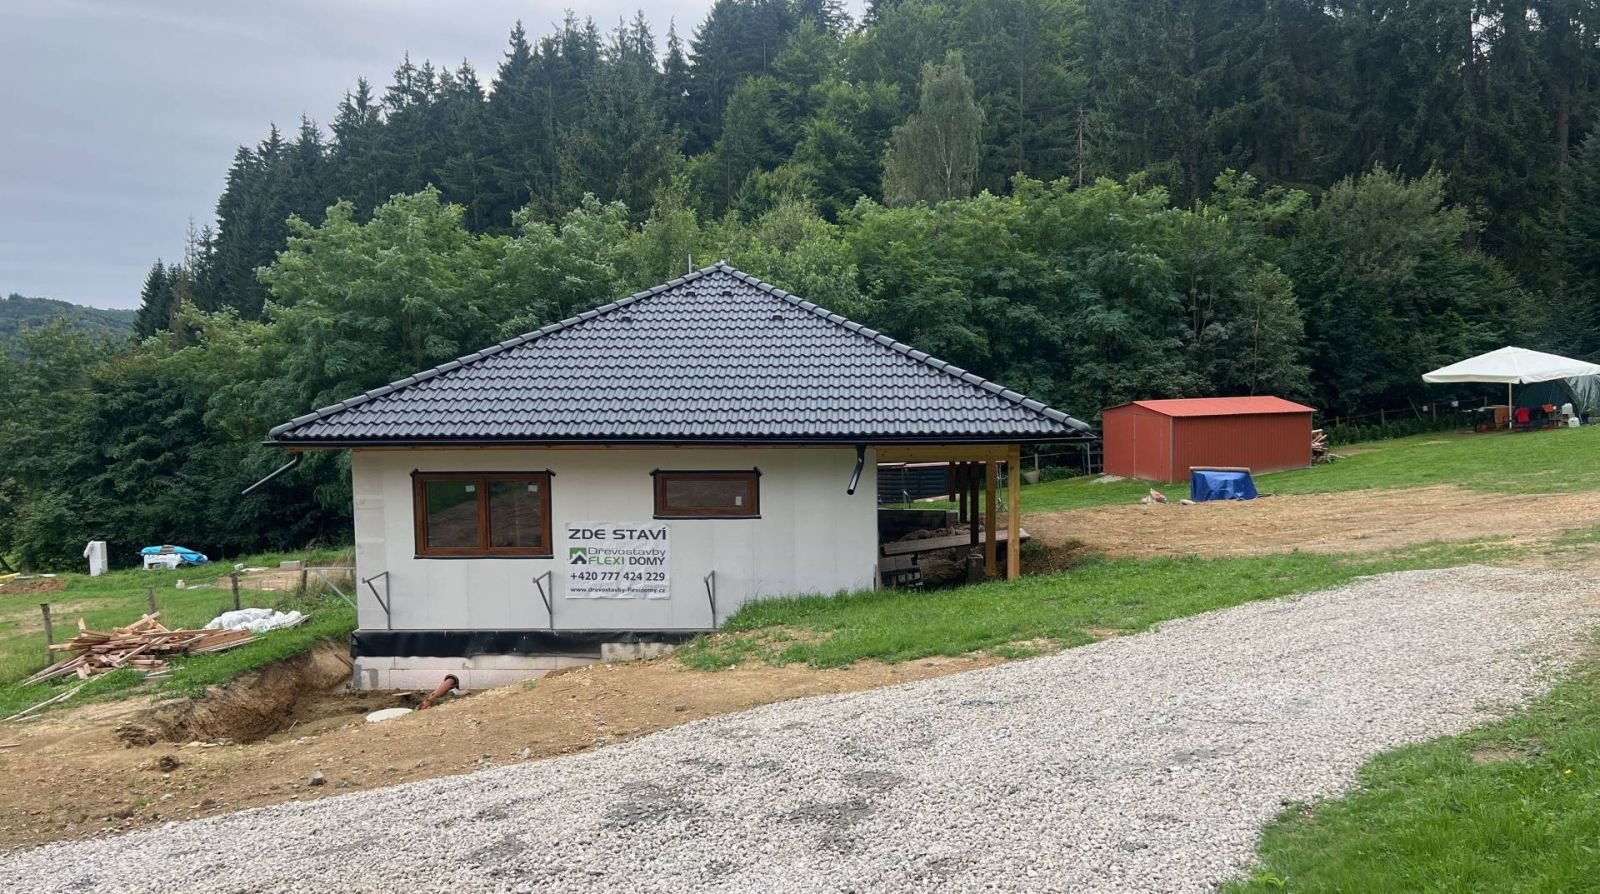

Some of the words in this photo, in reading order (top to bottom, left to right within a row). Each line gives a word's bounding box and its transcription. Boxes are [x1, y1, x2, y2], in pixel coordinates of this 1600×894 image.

[568, 529, 606, 540] ZDE
[612, 527, 667, 540] STAVÍ
[588, 556, 625, 565] FLEXI
[629, 556, 665, 566] DOMY
[570, 572, 598, 581] +420
[600, 572, 620, 581] 777
[623, 572, 643, 581] 424
[645, 572, 665, 581] 229
